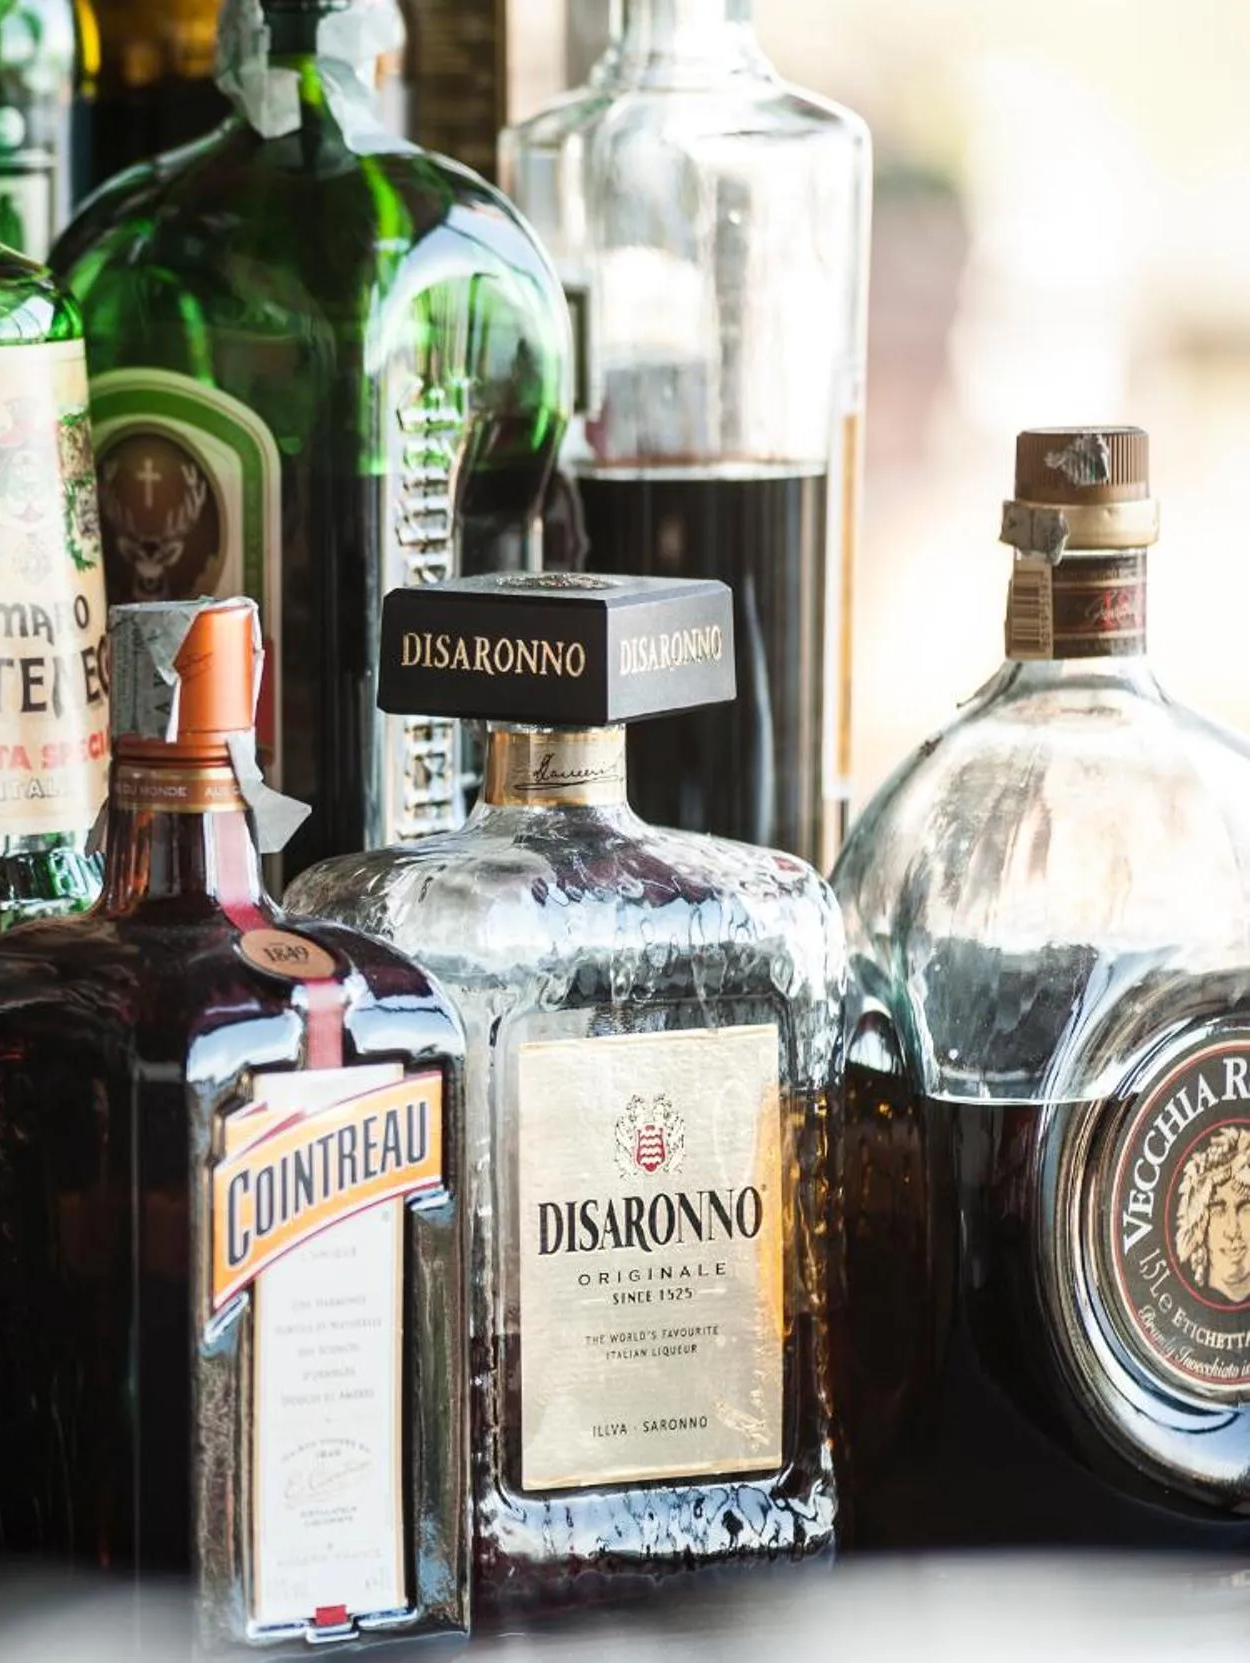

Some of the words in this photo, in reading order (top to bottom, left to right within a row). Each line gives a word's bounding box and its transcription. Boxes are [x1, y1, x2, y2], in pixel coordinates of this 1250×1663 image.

[401, 631, 586, 679] DISARONNO
[619, 624, 723, 677] DISARONNO
[264, 945, 310, 963] 1849
[1122, 1072, 1220, 1255] VECCHIA
[227, 1101, 427, 1268] COINTREAU
[537, 1185, 763, 1256] DISARONNO
[577, 1261, 727, 1286] ORIGINALE
[612, 1290, 652, 1305] SINCE
[659, 1287, 693, 1302] 1525
[585, 1334, 605, 1346] THE
[609, 1330, 657, 1345] WORLD'S
[661, 1325, 720, 1339] FAVOURITE
[606, 1347, 647, 1361] ITALIAN
[651, 1344, 698, 1358] LIQUEUR
[591, 1423, 628, 1439] ILLVA
[642, 1415, 708, 1433] SARONNO
